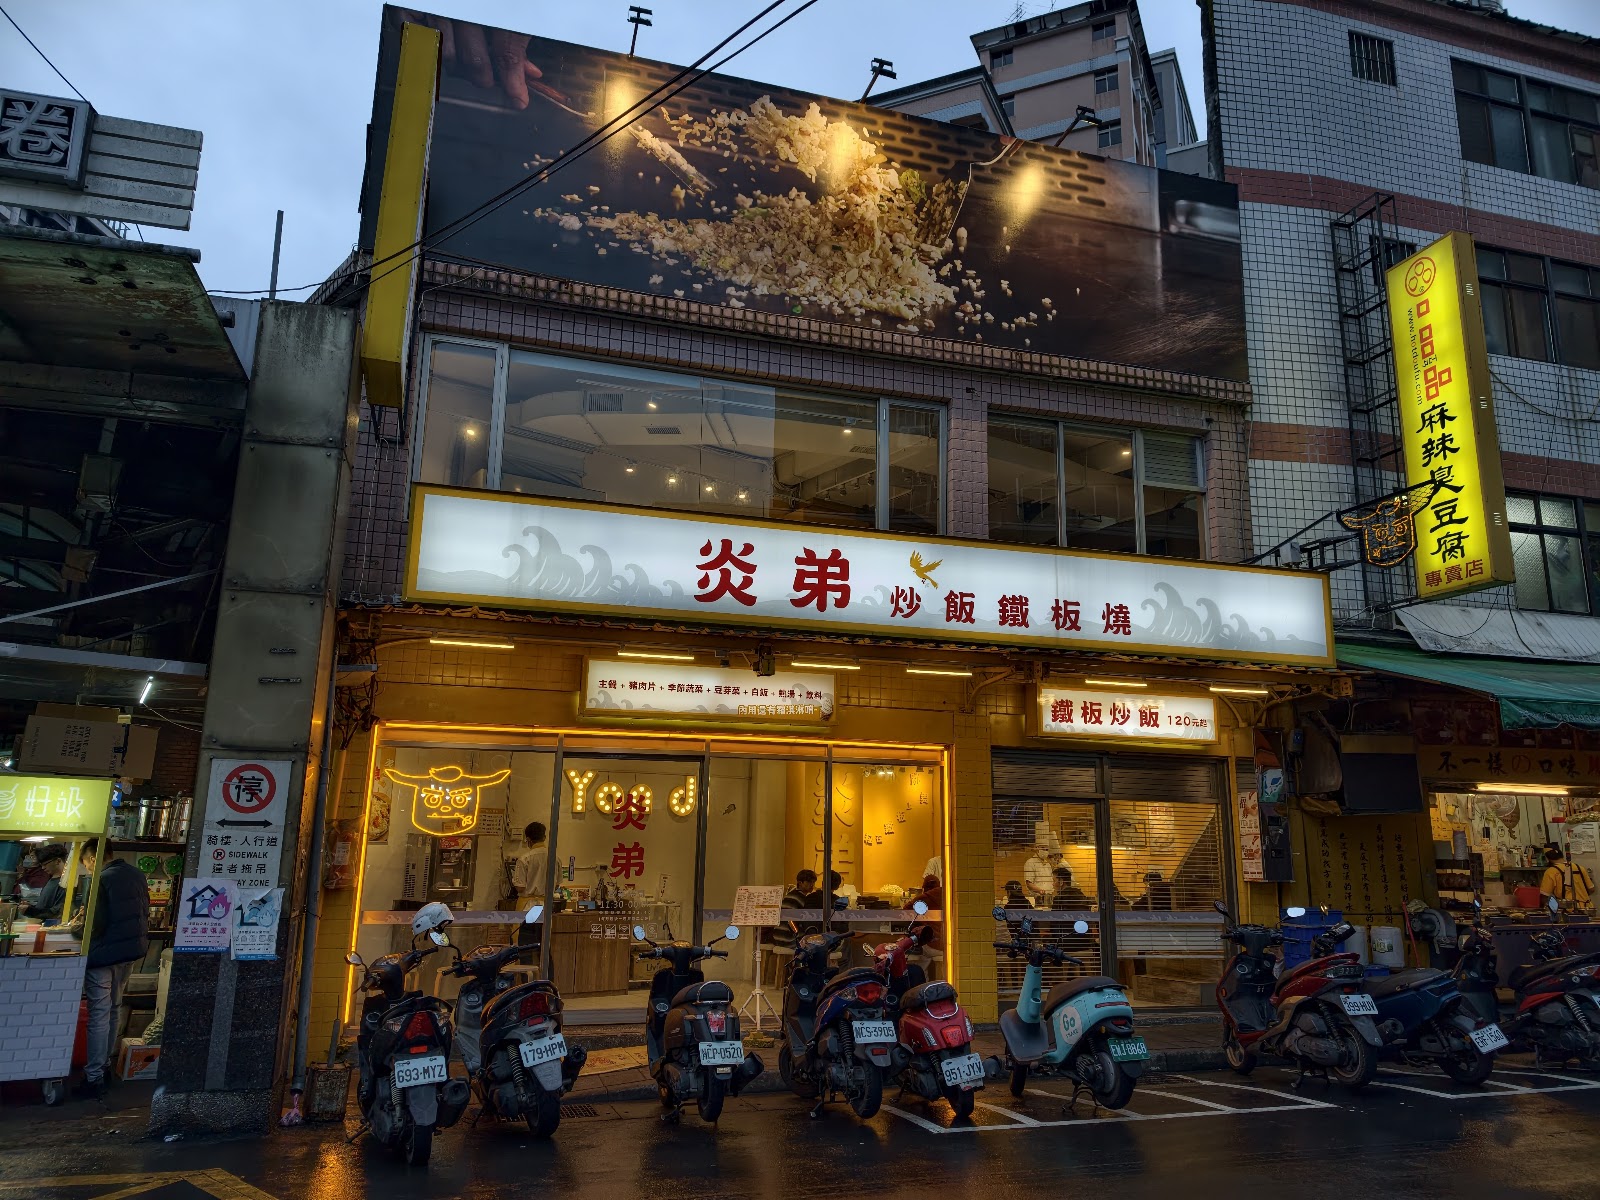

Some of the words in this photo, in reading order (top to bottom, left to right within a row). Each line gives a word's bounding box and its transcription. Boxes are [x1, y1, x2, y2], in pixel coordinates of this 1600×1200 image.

[1415, 402, 1469, 564] 麻辣臭豆腐
[1424, 558, 1484, 588] 專賣店
[693, 537, 852, 614] 炎弟
[890, 584, 1132, 637] 炒飯鐵板燒
[1050, 699, 1160, 729] 鐵板炒飯
[1167, 715, 1208, 728] 120元起
[234, 775, 264, 803] 停
[610, 793, 647, 880] 炎弟
[228, 851, 268, 859] SIDEWALK
[249, 879, 270, 887] ZONE
[854, 1026, 895, 1039] NCS-3905
[1062, 1013, 1076, 1032] Go
[524, 1040, 567, 1065] 179-HPM
[700, 1046, 743, 1061] NCP-0520
[396, 1064, 446, 1084] 693-MYZ
[944, 1061, 982, 1083] 951-JYV
